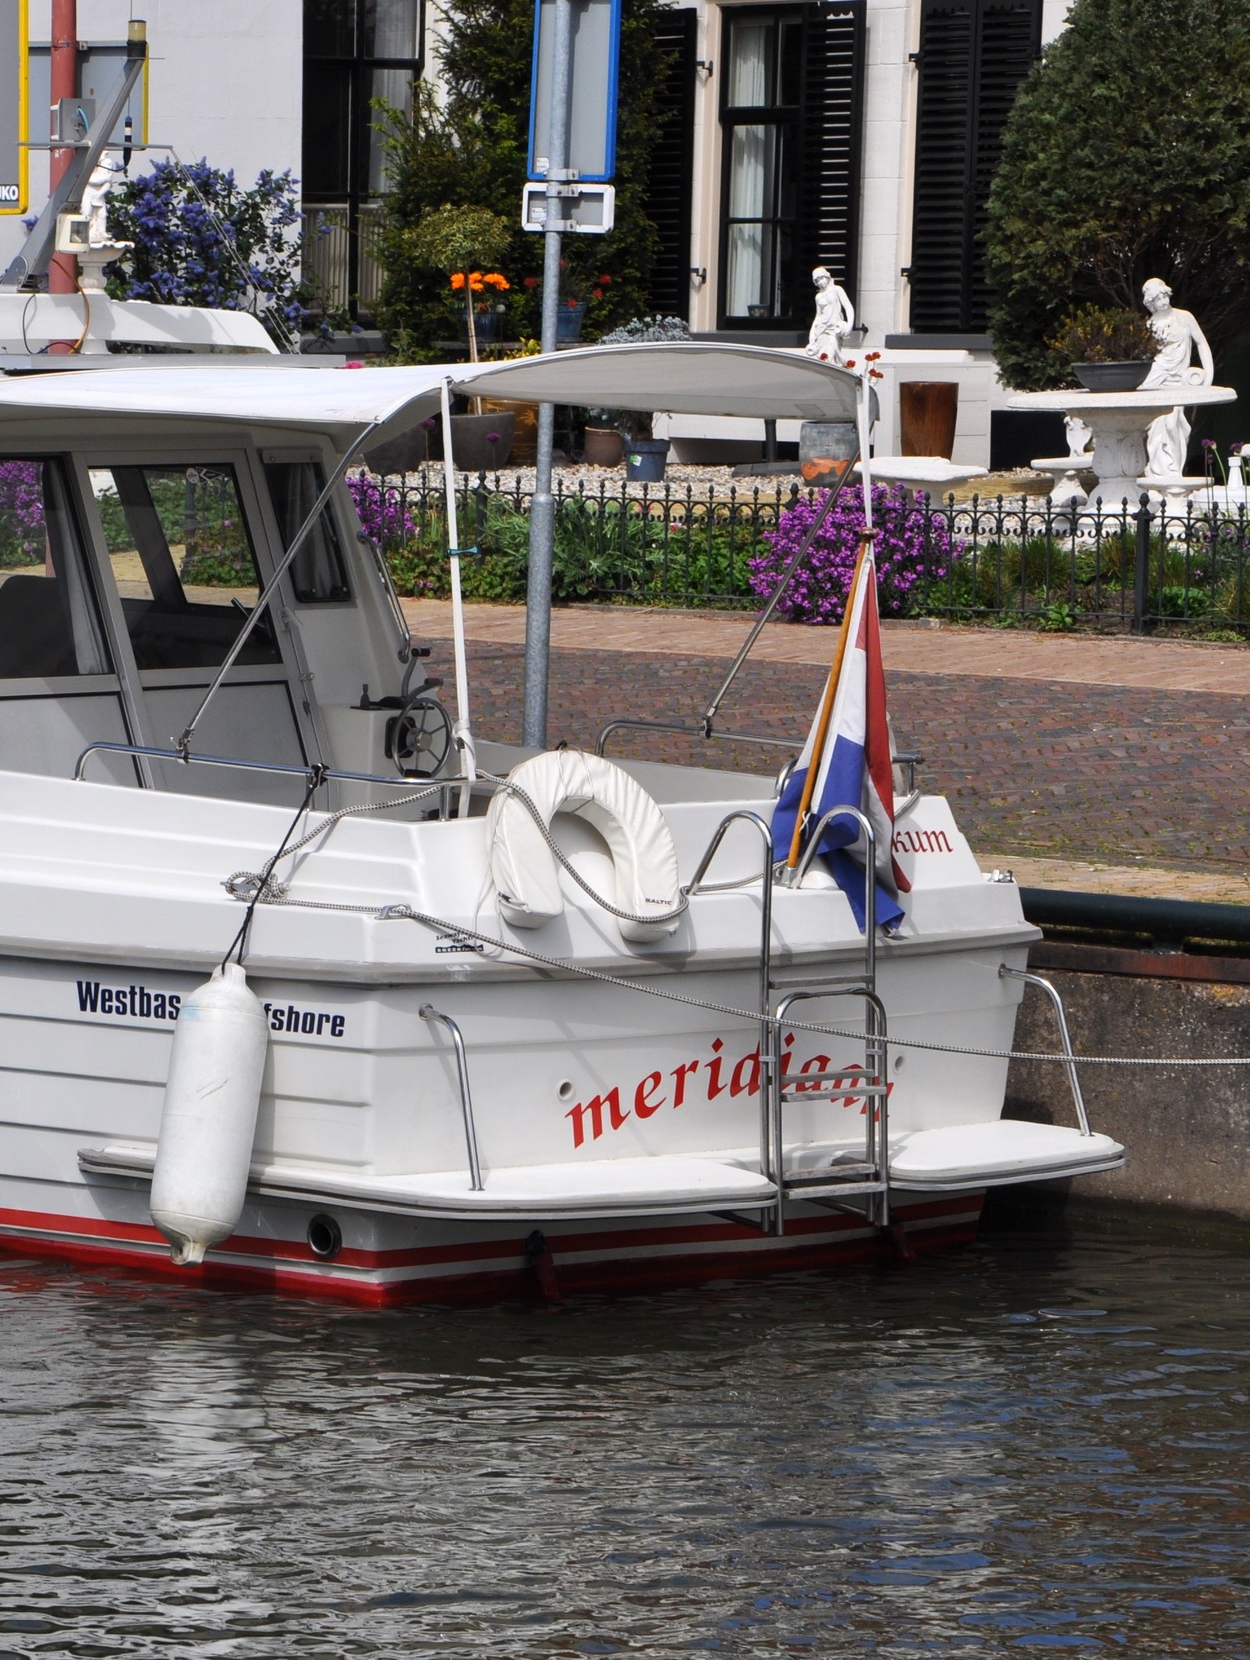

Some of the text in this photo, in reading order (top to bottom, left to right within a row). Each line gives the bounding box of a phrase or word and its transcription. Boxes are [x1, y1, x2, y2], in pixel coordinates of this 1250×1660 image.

[891, 830, 954, 853] kum
[645, 897, 673, 906] BALTIC
[76, 980, 346, 1038] Westbas fshore
